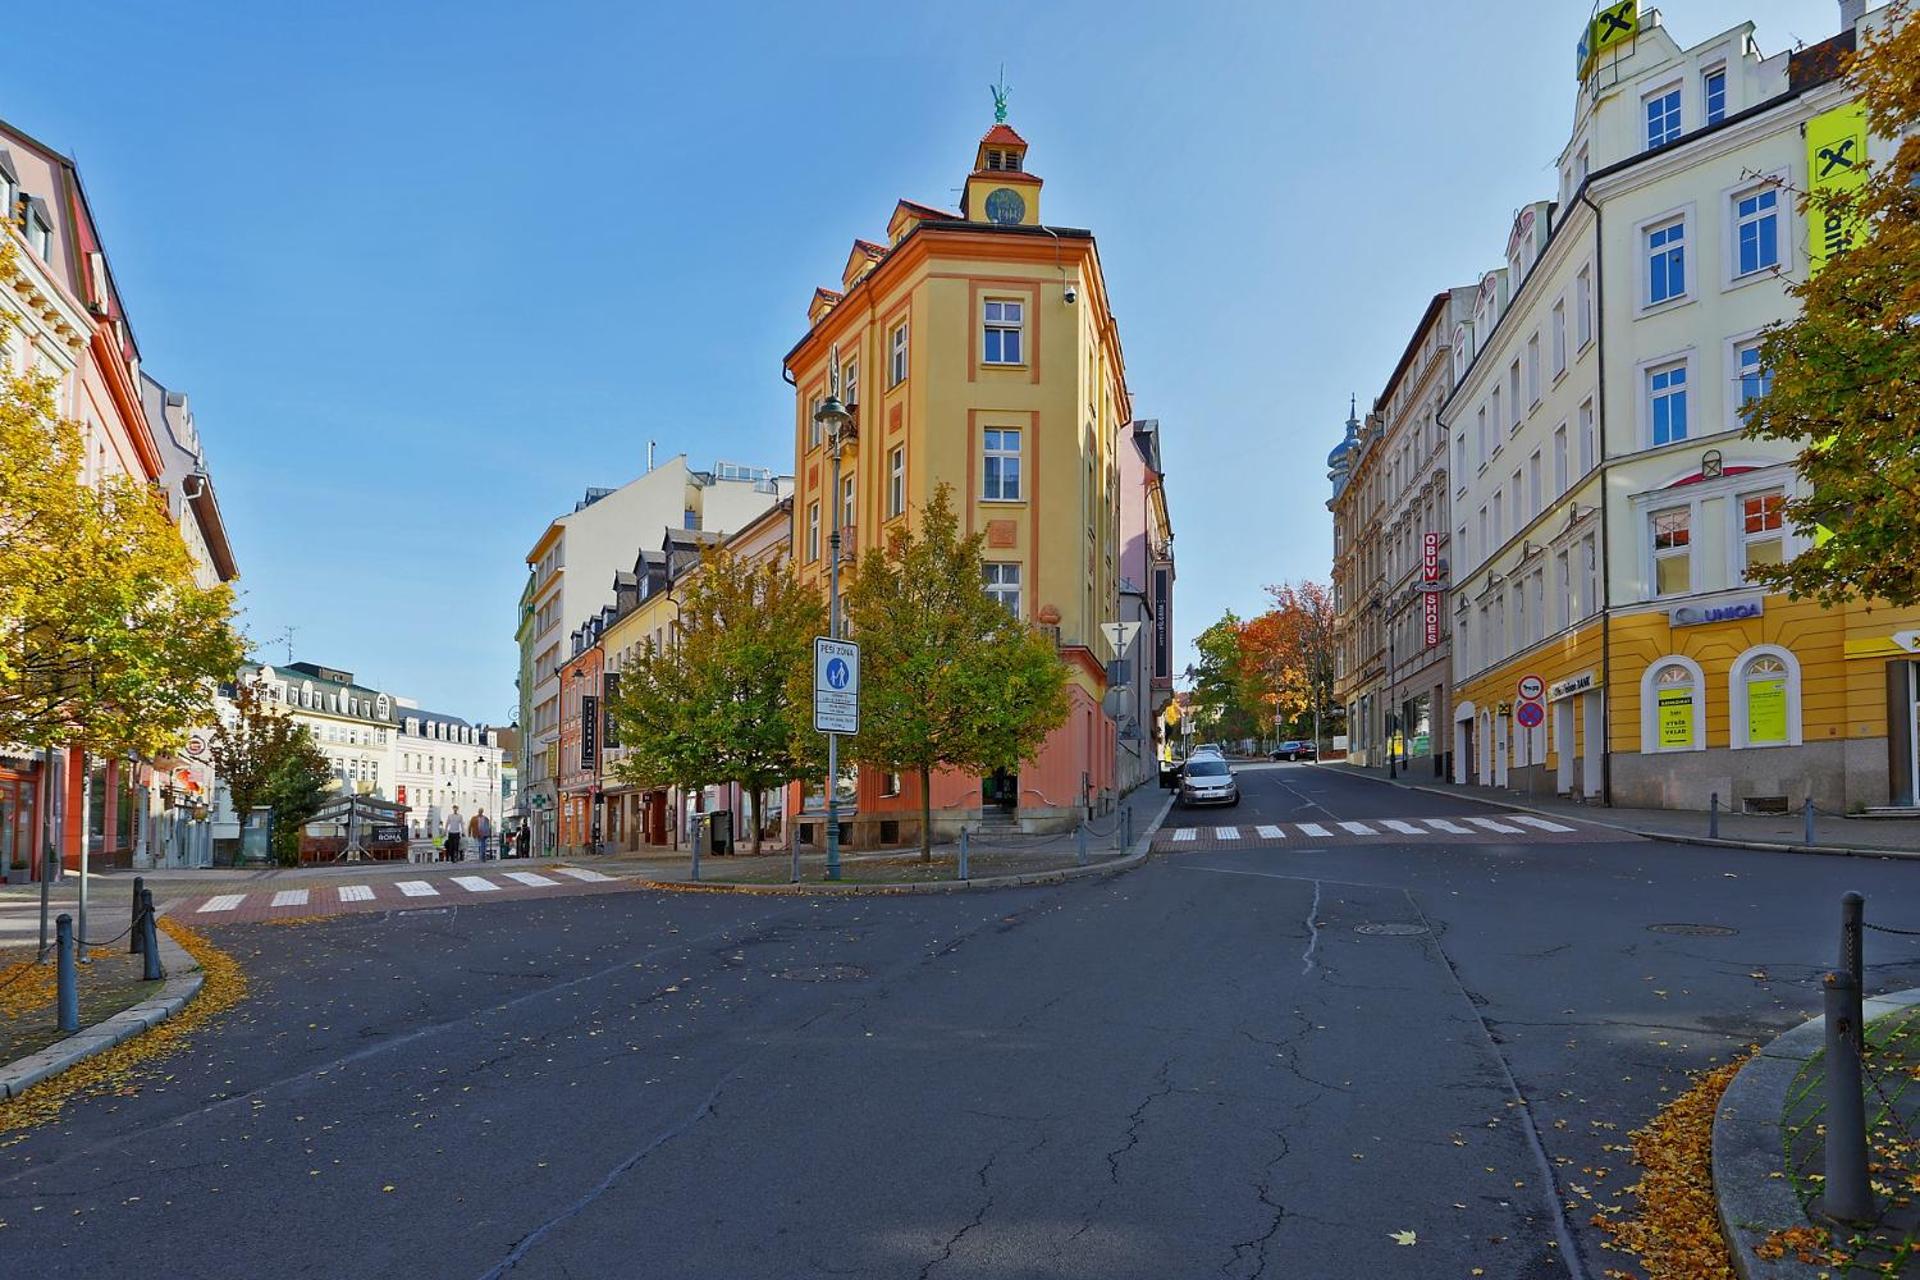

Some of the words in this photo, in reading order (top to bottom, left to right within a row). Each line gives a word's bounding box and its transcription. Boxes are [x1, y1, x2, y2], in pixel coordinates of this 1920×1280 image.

[1426, 535, 1437, 577] OBUV
[1427, 594, 1437, 644] SHOES
[1704, 604, 1757, 621] UNIQA
